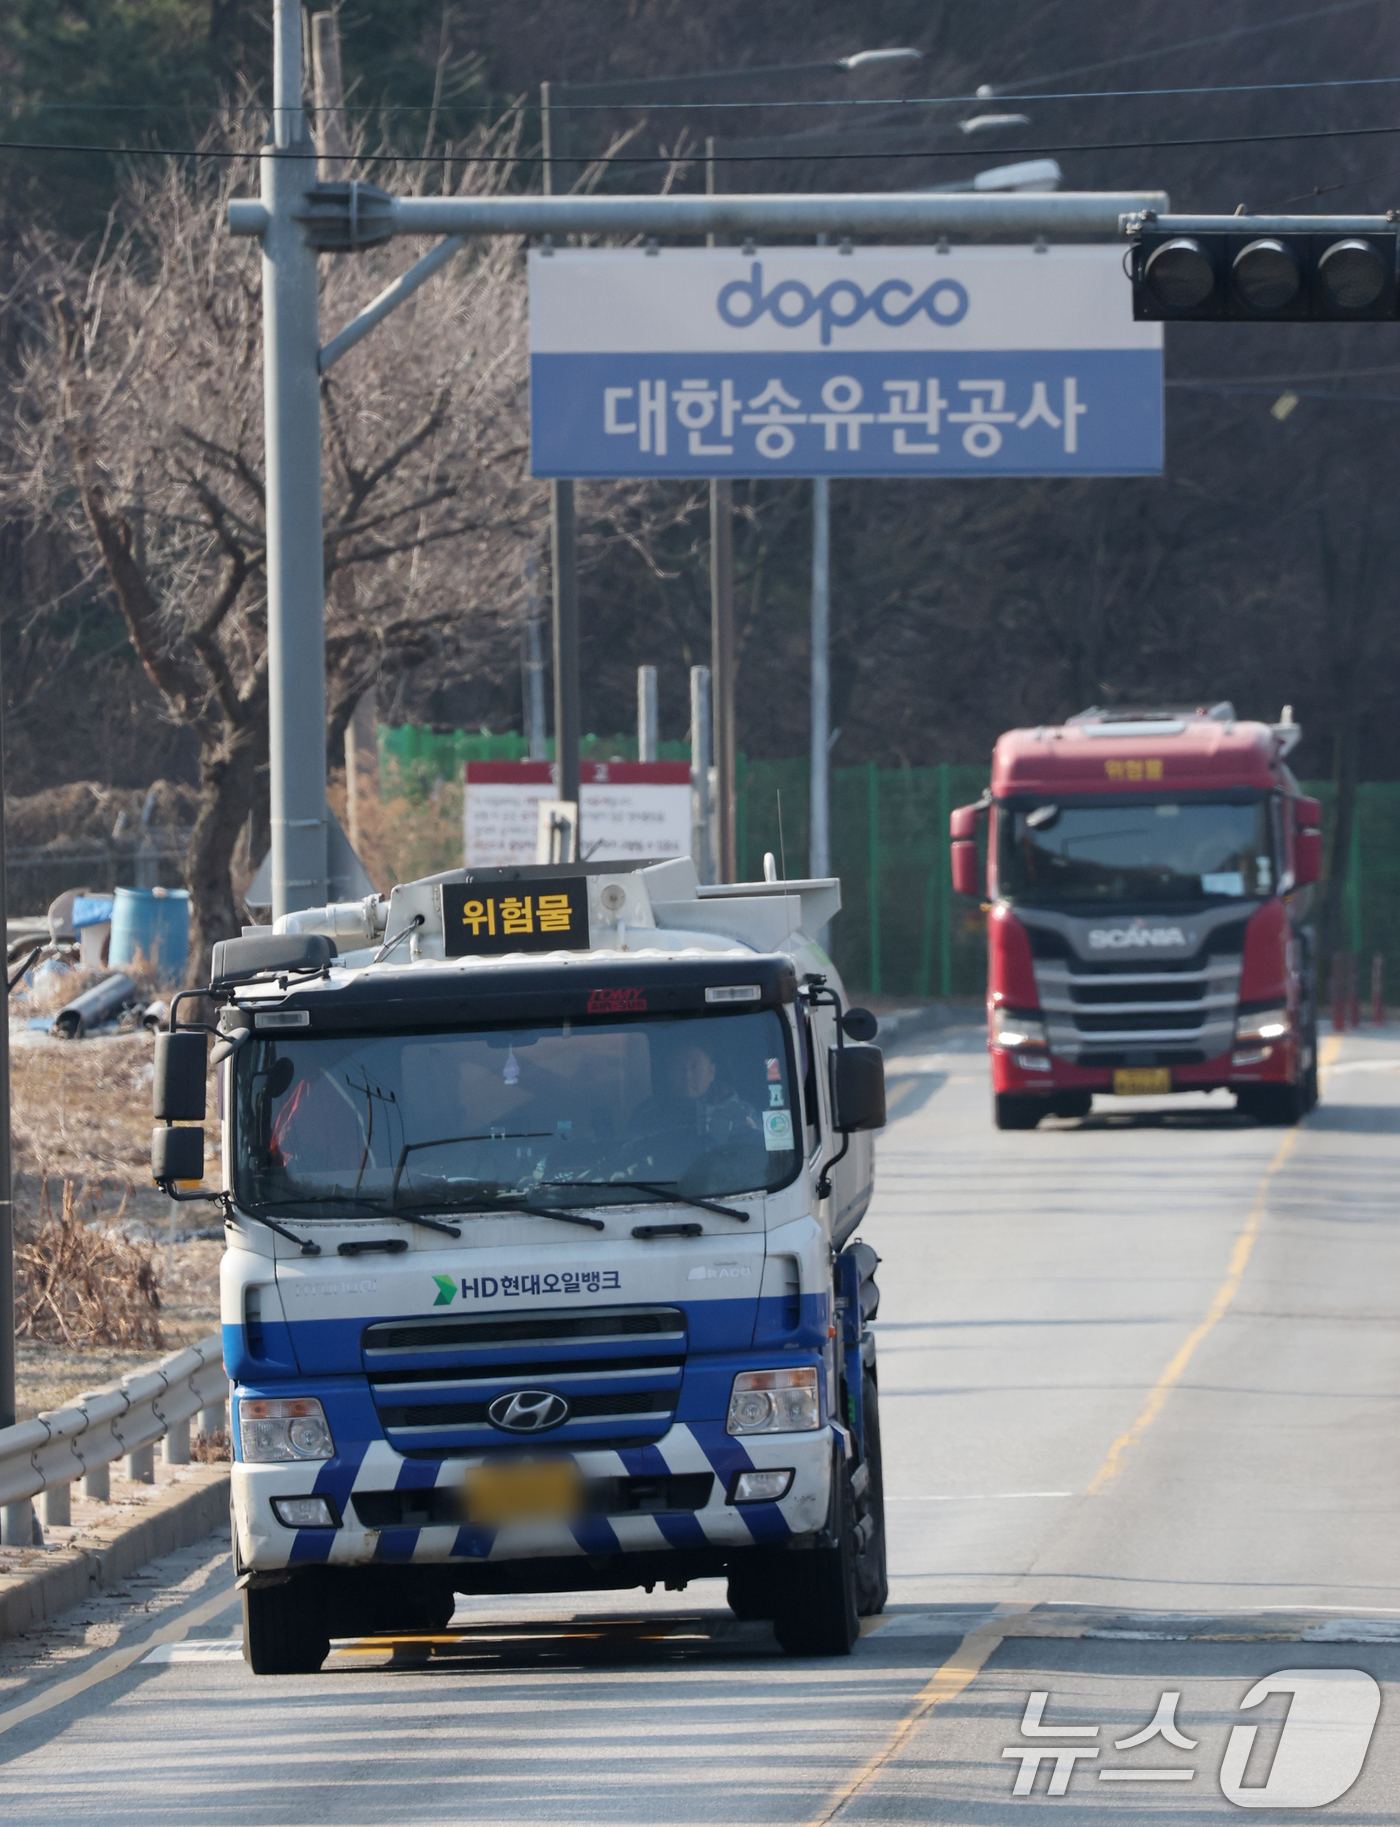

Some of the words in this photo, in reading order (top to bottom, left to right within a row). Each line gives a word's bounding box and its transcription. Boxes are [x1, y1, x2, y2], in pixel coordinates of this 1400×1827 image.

[716, 260, 969, 346] dopco
[603, 375, 1087, 458] 대한송유관공사
[462, 894, 572, 936] 위험물
[1088, 926, 1186, 948] SCANIA
[461, 1270, 621, 1299] HD현대오일뱅크
